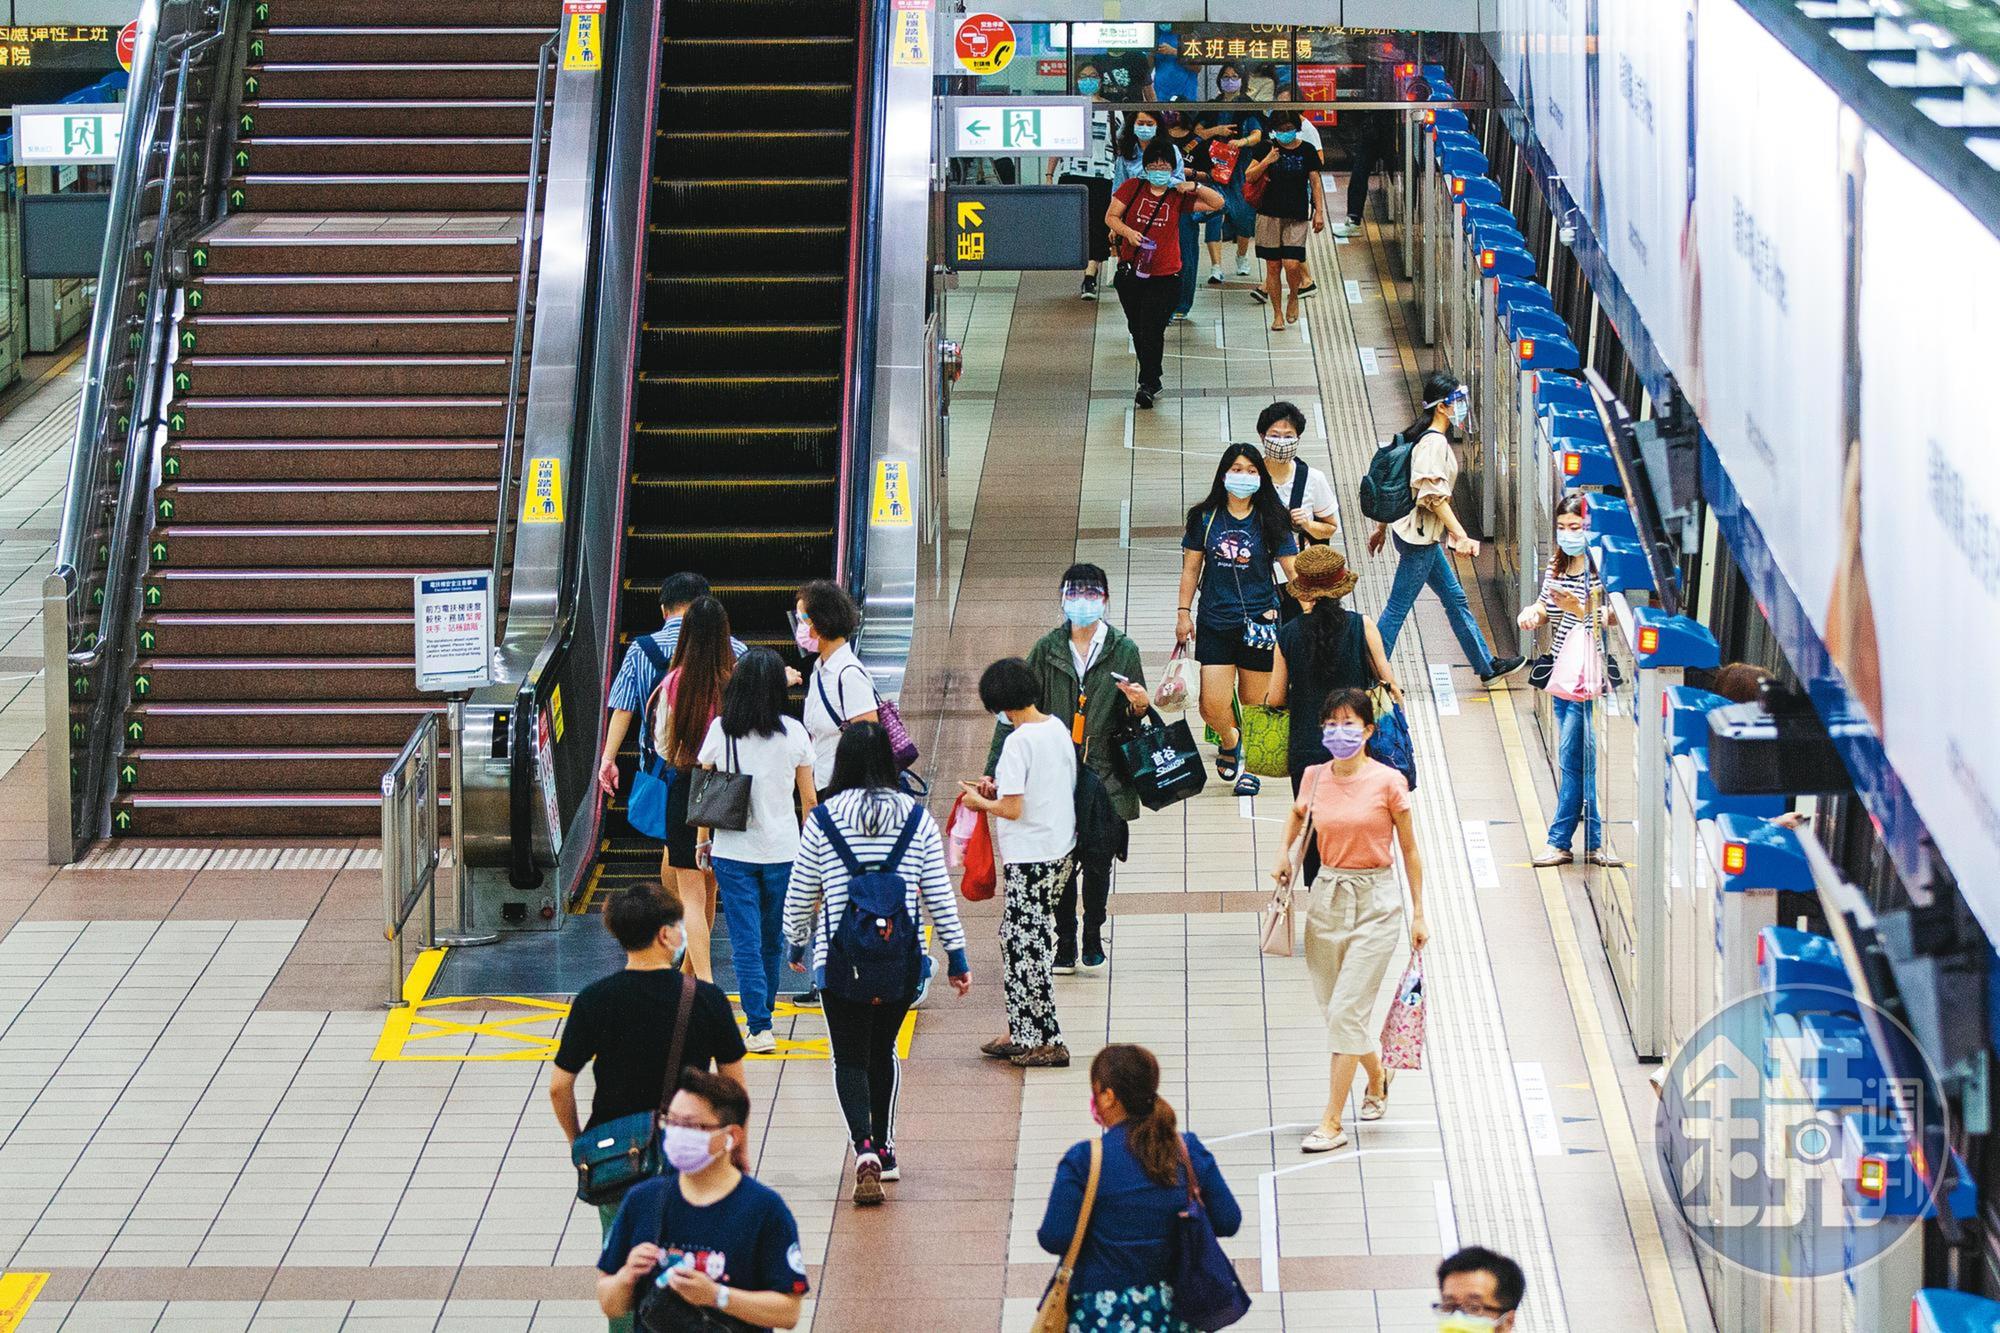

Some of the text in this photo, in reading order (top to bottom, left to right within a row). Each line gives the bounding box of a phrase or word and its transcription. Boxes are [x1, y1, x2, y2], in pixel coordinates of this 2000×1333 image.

[1182, 38, 1313, 60] 本班車往昆陽
[957, 232, 985, 261] 出口
[536, 460, 553, 497] 站穩踏階
[426, 602, 482, 614] 前方電扶梯速度
